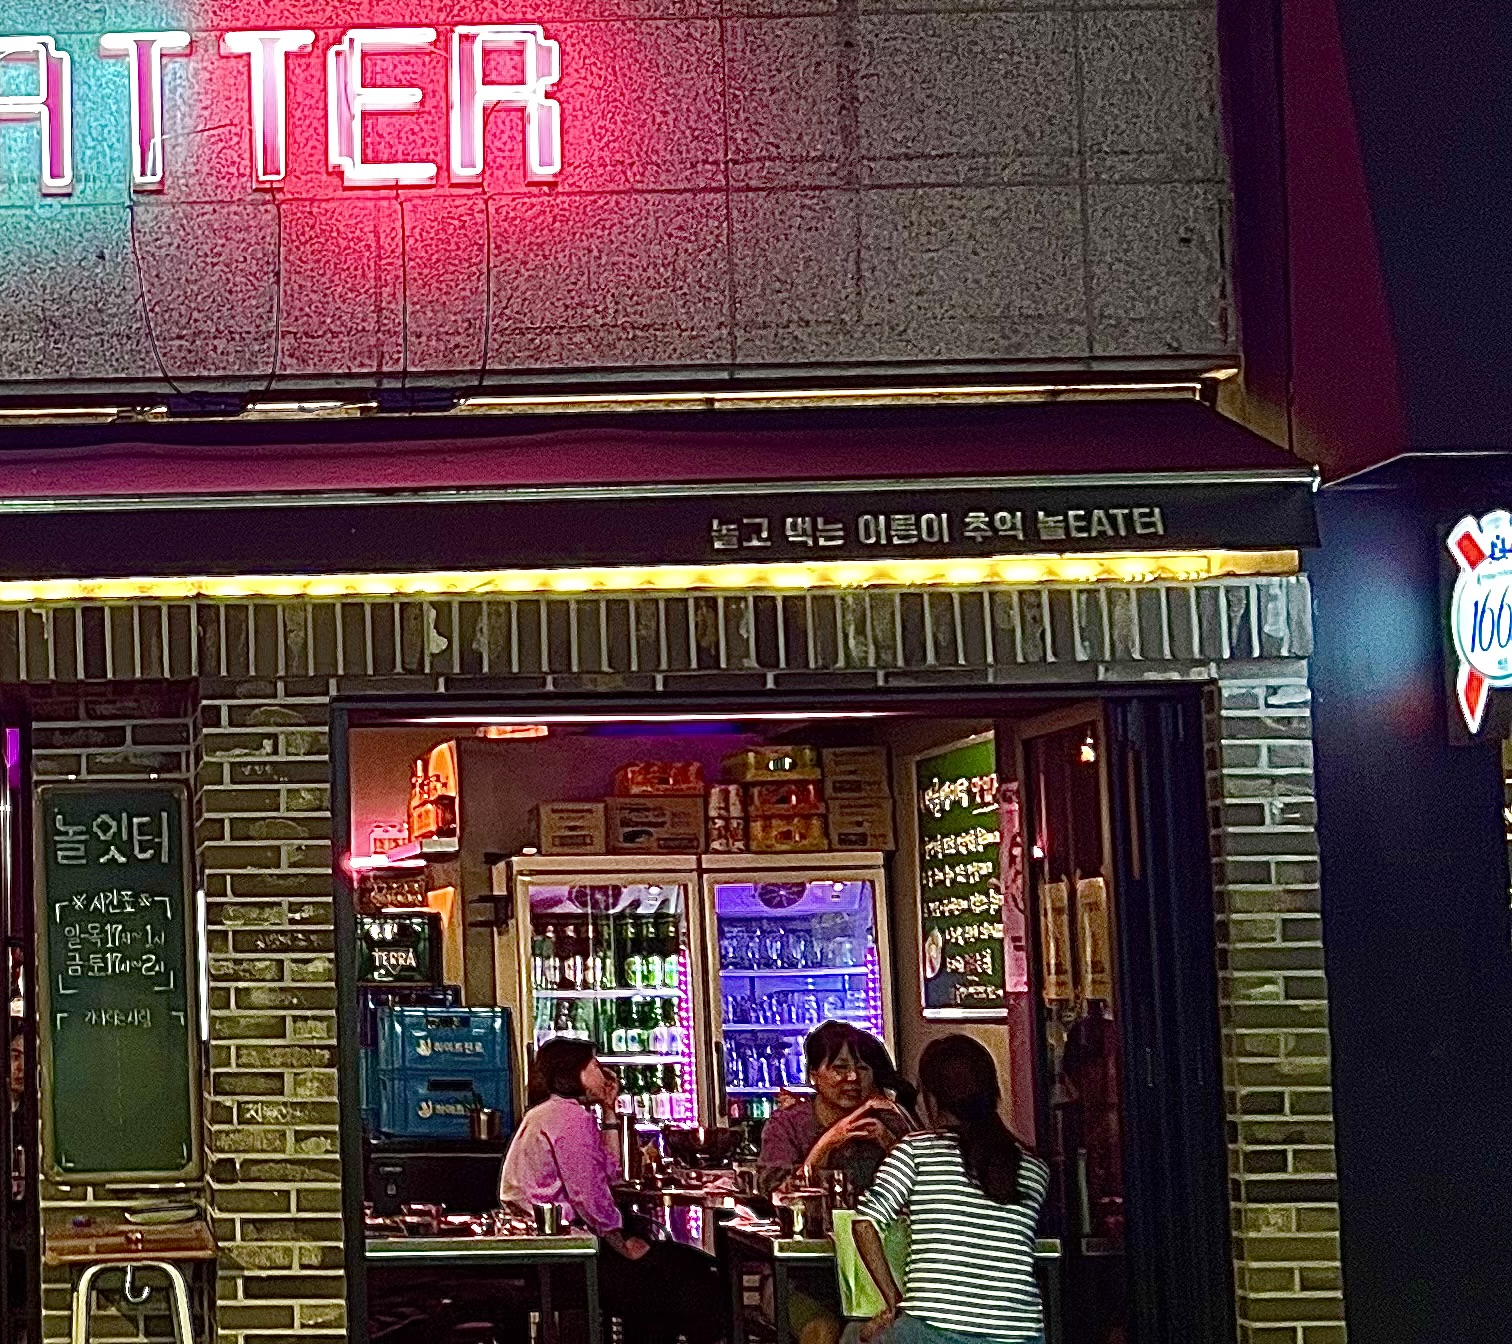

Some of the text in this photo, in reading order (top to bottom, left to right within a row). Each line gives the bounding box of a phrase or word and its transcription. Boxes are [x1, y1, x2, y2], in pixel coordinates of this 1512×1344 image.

[711, 516, 772, 549] 놀고
[785, 515, 845, 547] 먹는
[858, 512, 950, 545] 어른이
[963, 511, 1025, 542] 추억
[54, 811, 170, 865] 놀잇터
[372, 947, 416, 968] TERRA
